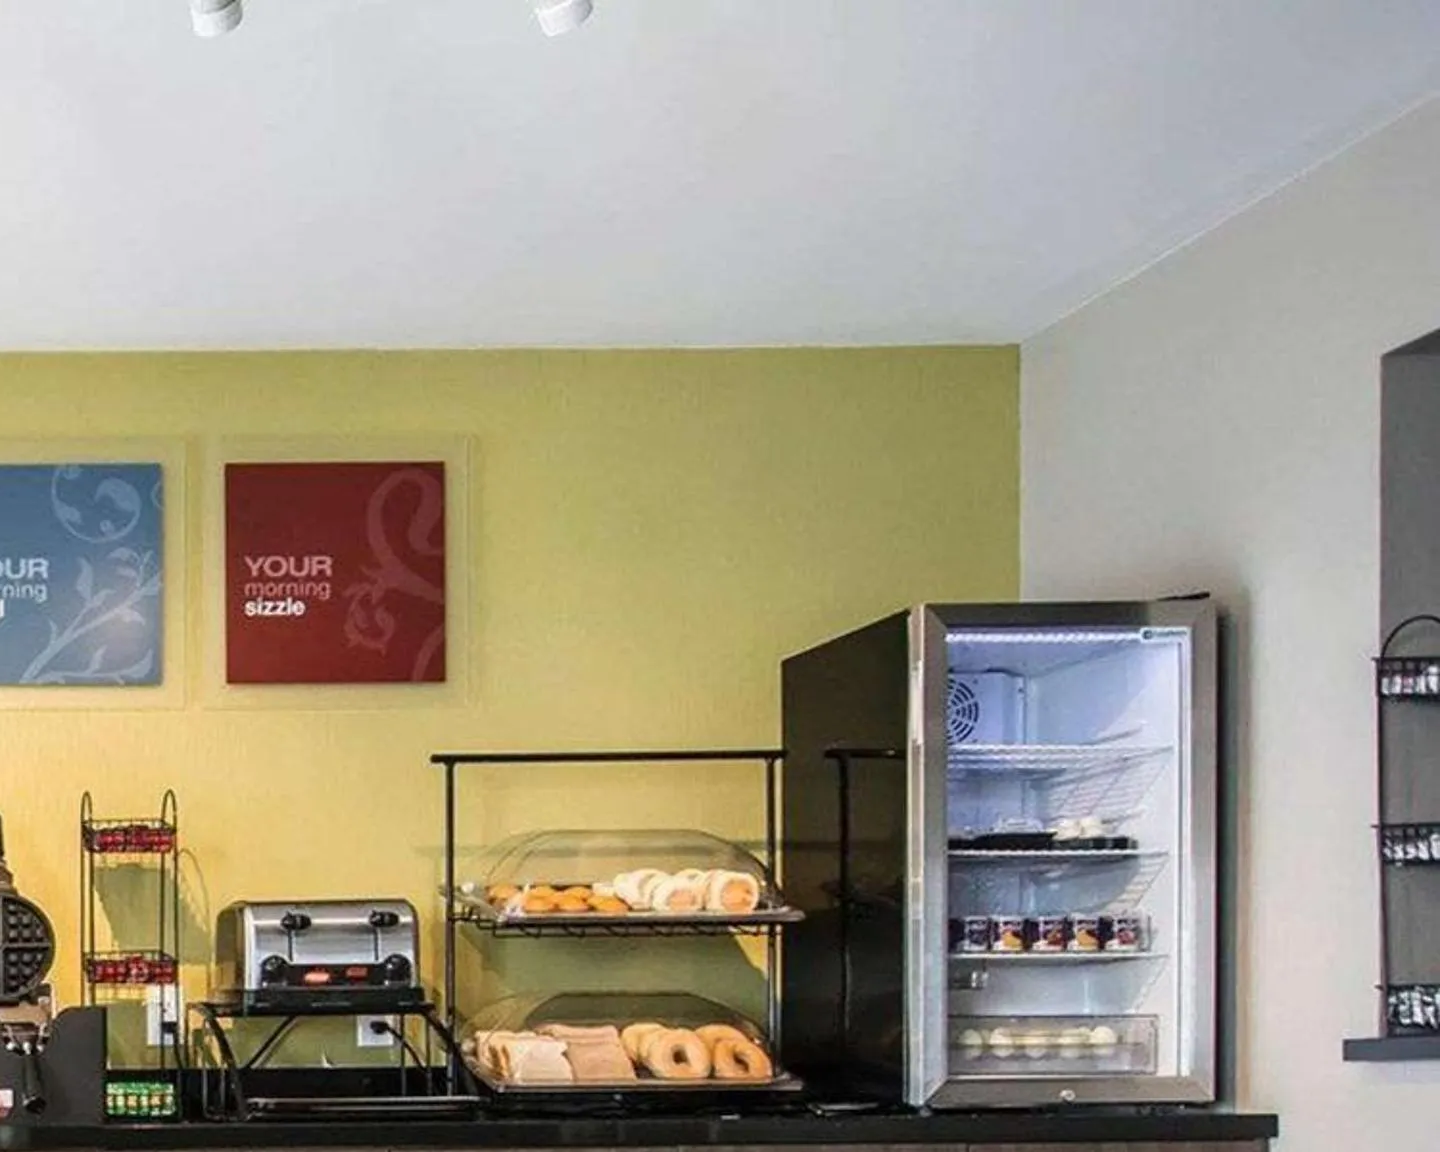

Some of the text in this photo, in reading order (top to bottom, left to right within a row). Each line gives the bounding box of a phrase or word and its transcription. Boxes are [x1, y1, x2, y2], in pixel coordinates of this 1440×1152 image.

[244, 555, 333, 577] YOUR
[244, 581, 331, 600] morning
[244, 597, 304, 616] sizzle
